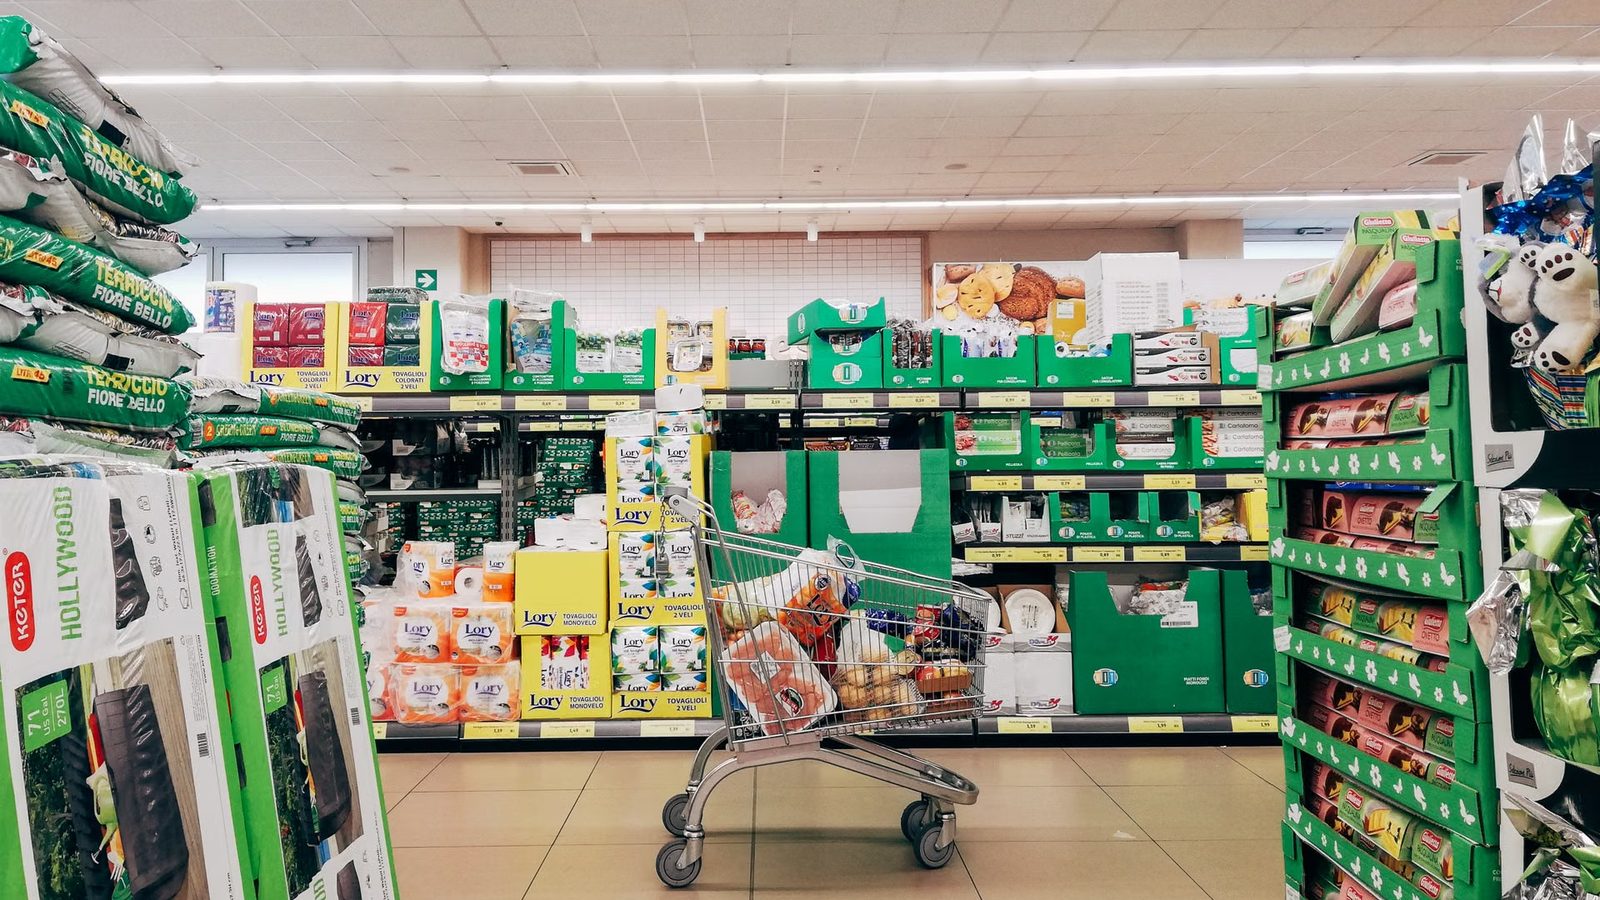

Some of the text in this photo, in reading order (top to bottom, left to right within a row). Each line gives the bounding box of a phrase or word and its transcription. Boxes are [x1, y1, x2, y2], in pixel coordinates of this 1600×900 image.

[84, 151, 164, 208] FIORE BELLO
[96, 260, 172, 314] TERRICCIO
[92, 284, 130, 312] FIORE
[134, 300, 172, 330] BELLO
[82, 365, 168, 396] TERRICCIO
[250, 370, 286, 385] Lory
[346, 370, 382, 386] Lory
[88, 388, 165, 414] FIORE BELLO
[206, 426, 212, 436] 2
[620, 448, 640, 458] Lory
[667, 448, 688, 458] Lory
[616, 508, 652, 524] Lory
[622, 544, 642, 552] Lory
[671, 544, 692, 553] Lory
[53, 486, 82, 640] HOLLYWOOD
[206, 545, 221, 596] HOLLYWOOD
[266, 528, 289, 638] HOLLYWOOD
[524, 610, 558, 626] Lory
[618, 602, 655, 619] Lory
[404, 622, 432, 636] Lory
[465, 624, 494, 638] Lory
[1422, 631, 1440, 641] OVETTO
[624, 638, 644, 646] Lory
[672, 638, 693, 646] Lory
[266, 684, 276, 703] 71
[414, 682, 443, 695] Lory
[54, 688, 68, 728] 270L
[530, 694, 564, 710] Lory
[620, 694, 658, 711] Lory
[28, 709, 42, 737] 71
[44, 718, 50, 736] US
